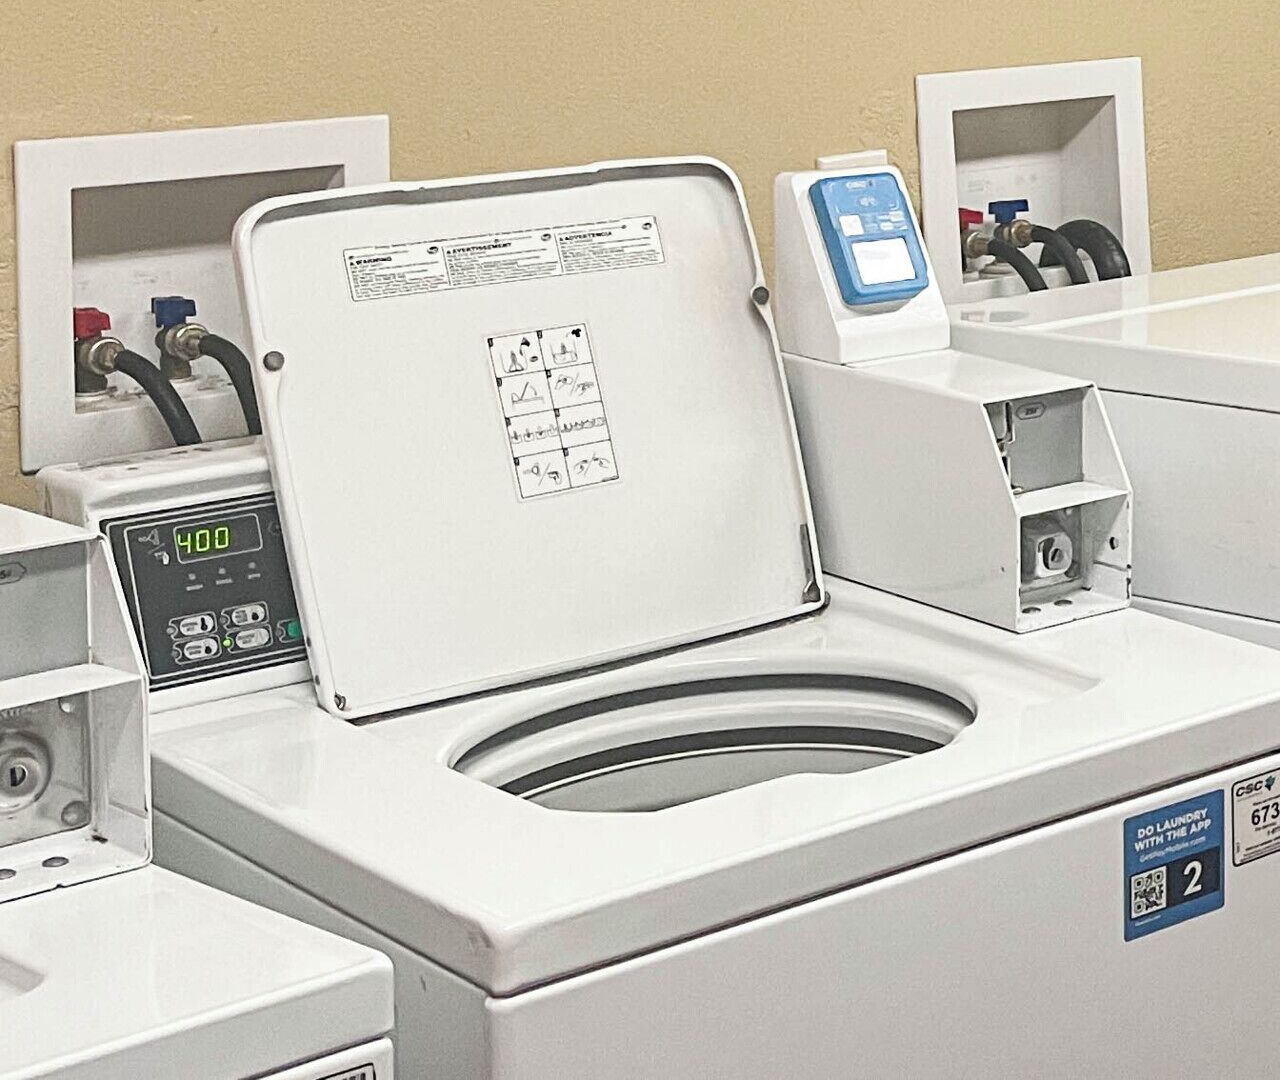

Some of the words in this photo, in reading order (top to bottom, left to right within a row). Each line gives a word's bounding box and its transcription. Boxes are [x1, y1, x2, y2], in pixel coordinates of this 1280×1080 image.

[177, 527, 230, 553] 400
[1235, 780, 1263, 797] CSC
[1134, 834, 1164, 852] WITH
[1166, 826, 1187, 841] THE
[1189, 818, 1212, 835] APP
[1137, 825, 1154, 839] DO
[1156, 807, 1208, 832] LAUNDRY
[1182, 860, 1203, 897] 2
